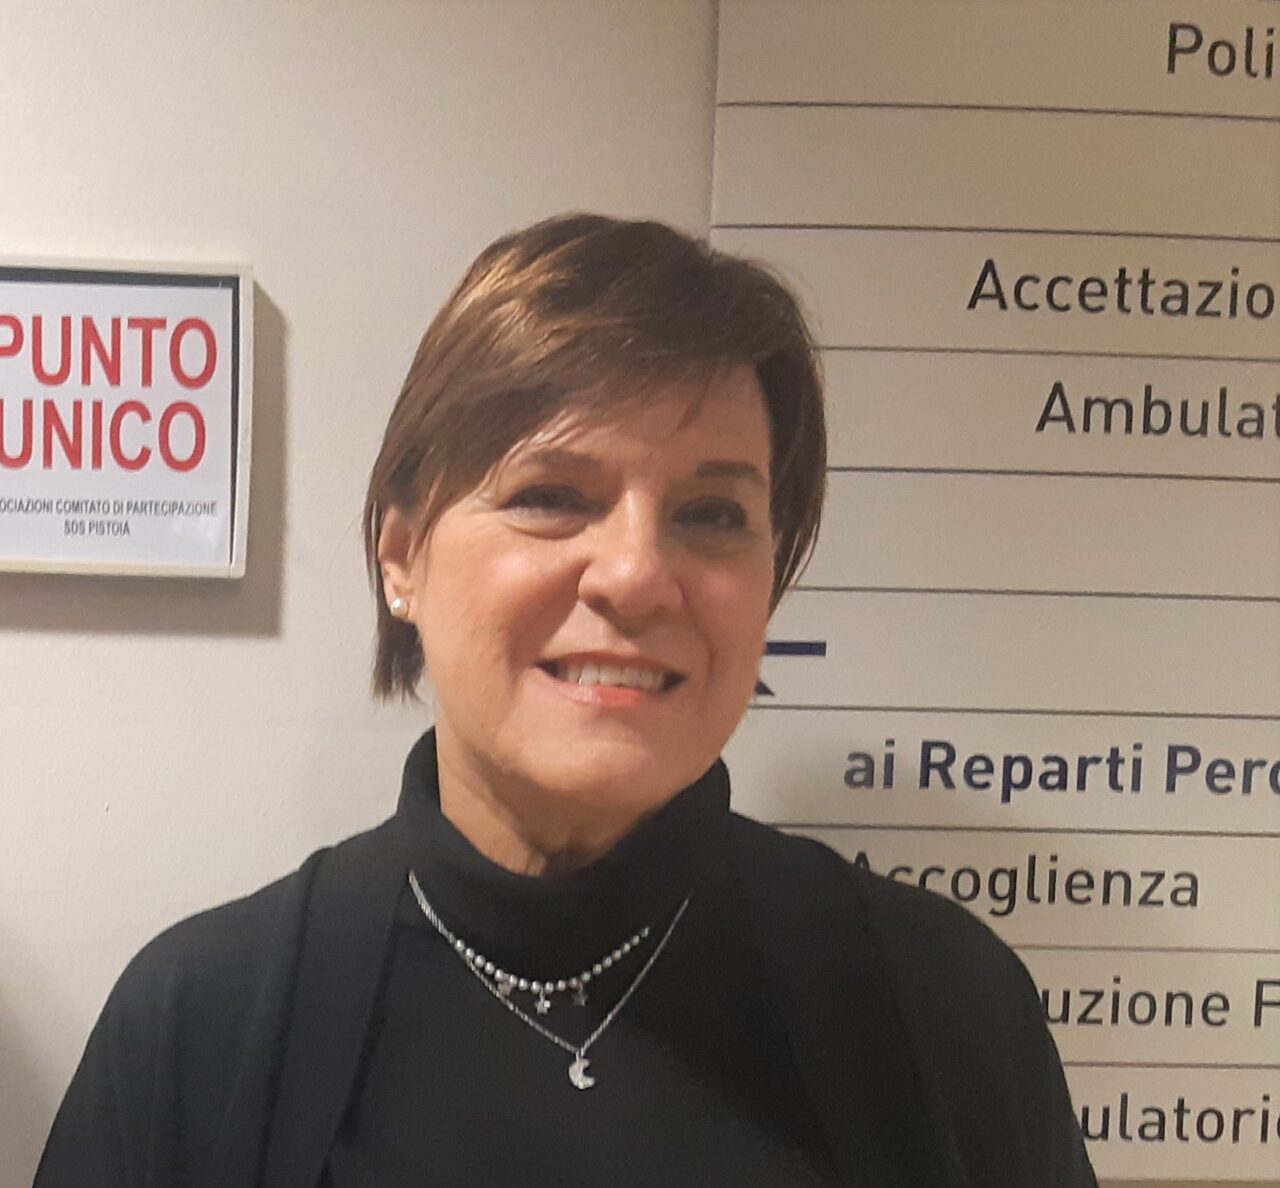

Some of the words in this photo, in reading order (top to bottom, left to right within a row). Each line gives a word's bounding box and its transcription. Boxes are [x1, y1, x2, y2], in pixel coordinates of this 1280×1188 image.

[1167, 22, 1275, 79] Poli
[967, 258, 1275, 319] Accettazio
[56, 498, 110, 515] COMITATO
[113, 500, 124, 516] DI
[126, 500, 218, 517] PARTECIPAZIONE
[88, 519, 131, 536] PISTOIA
[843, 738, 896, 790] ai
[919, 739, 1144, 804] Reparti
